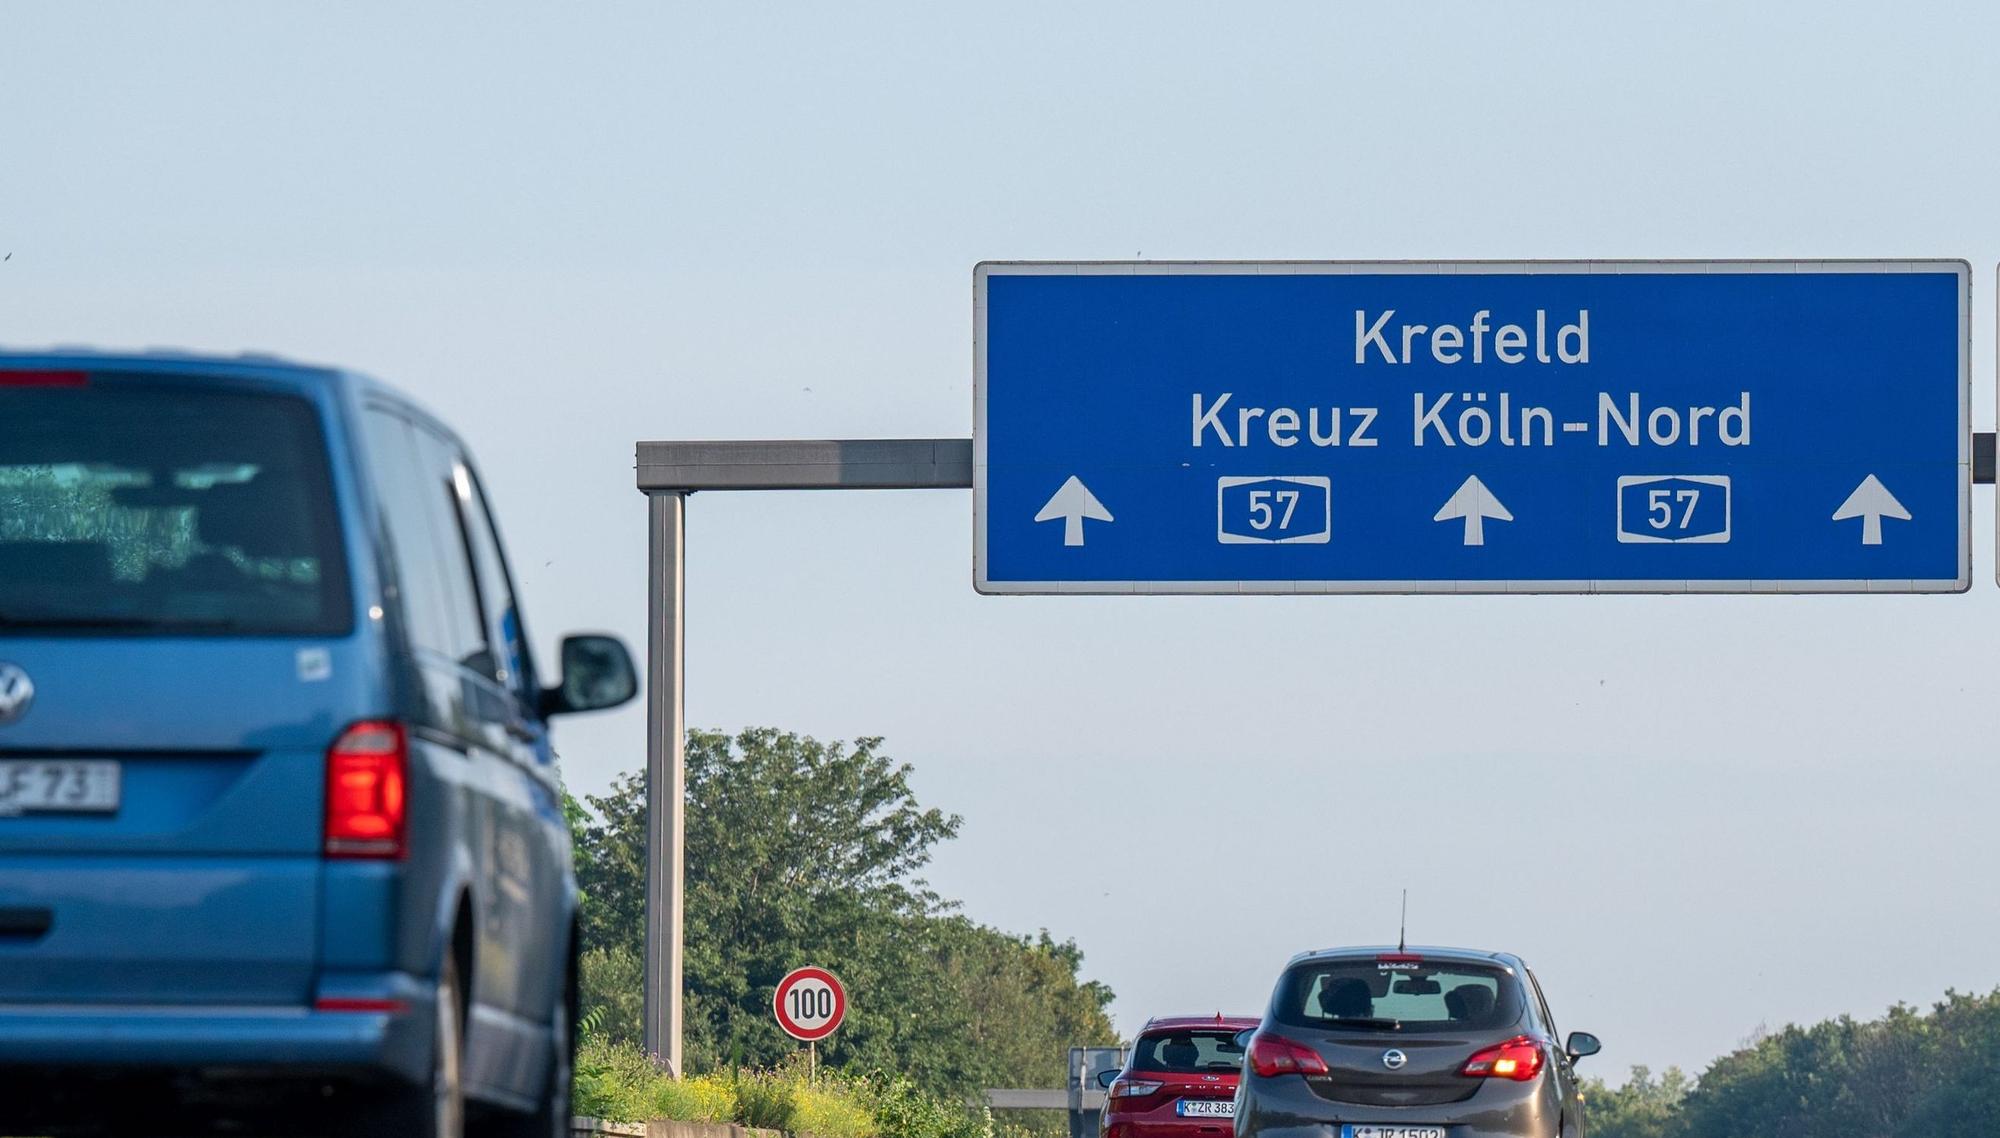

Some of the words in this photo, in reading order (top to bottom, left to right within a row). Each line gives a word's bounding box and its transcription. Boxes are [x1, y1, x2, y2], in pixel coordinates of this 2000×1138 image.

[1354, 309, 1590, 365] Krefeld
[1191, 391, 1379, 448] Kreuz
[1413, 390, 1751, 448] Köln-Nord
[1248, 490, 1299, 531] 57
[1647, 490, 1701, 530] 57
[790, 988, 832, 1020] 100
[1184, 1102, 1191, 1113] K
[1198, 1102, 1212, 1113] ZR
[1214, 1103, 1235, 1114] 383
